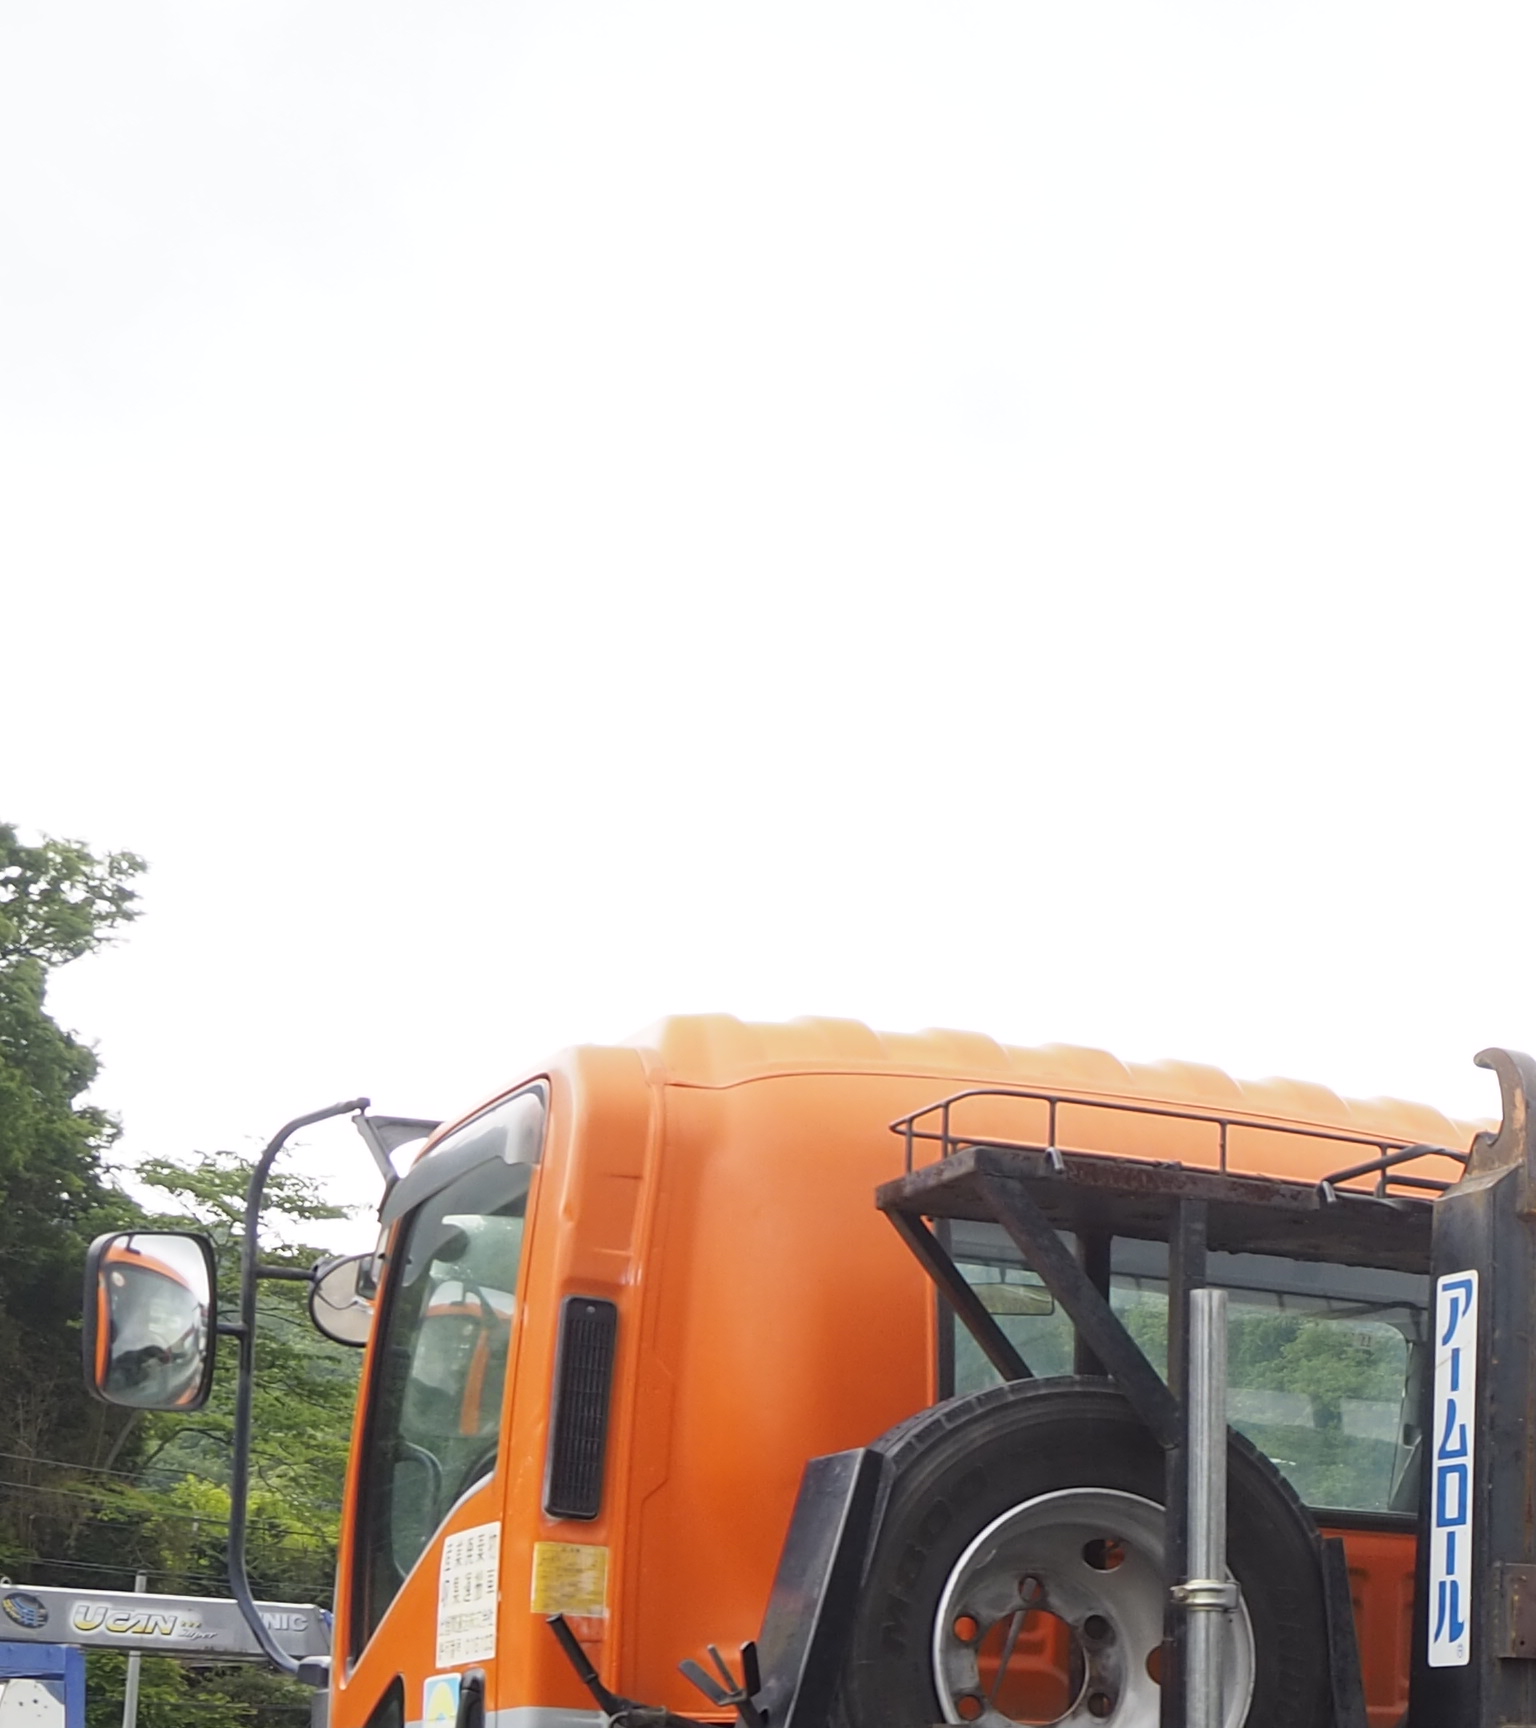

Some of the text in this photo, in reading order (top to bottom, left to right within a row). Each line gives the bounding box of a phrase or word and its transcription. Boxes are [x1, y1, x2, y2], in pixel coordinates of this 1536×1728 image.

[1432, 1279, 1473, 1645] アームロール
[73, 1603, 178, 1636] UCAN
